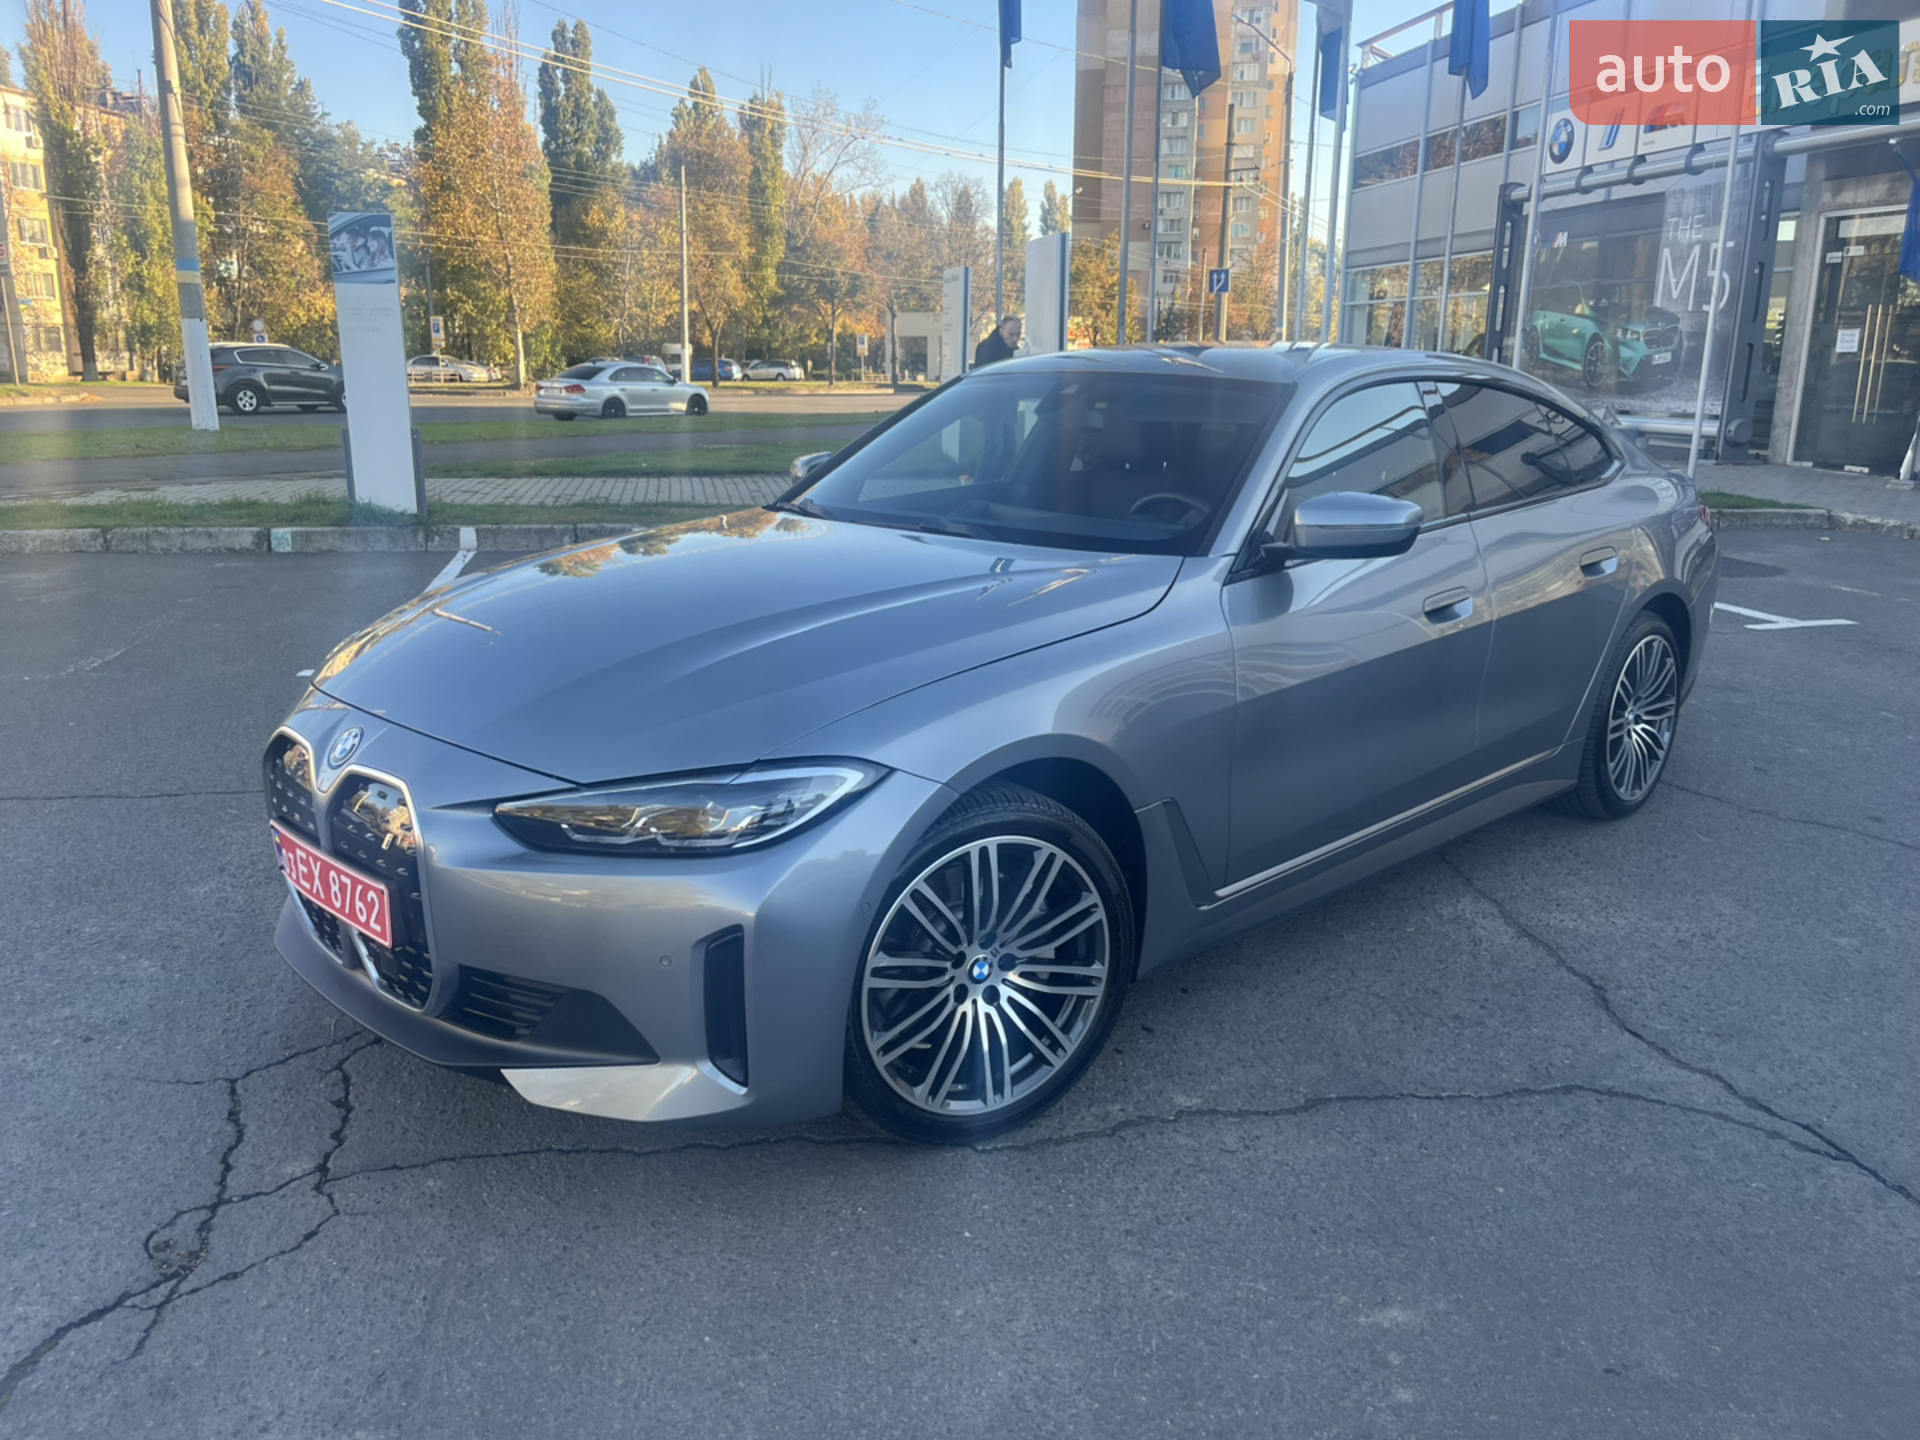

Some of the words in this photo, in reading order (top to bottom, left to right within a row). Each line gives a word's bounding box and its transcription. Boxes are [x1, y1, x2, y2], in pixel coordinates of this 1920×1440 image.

[1667, 214, 1705, 241] THE
[1656, 240, 1735, 312] M5
[329, 869, 382, 933] 8762
